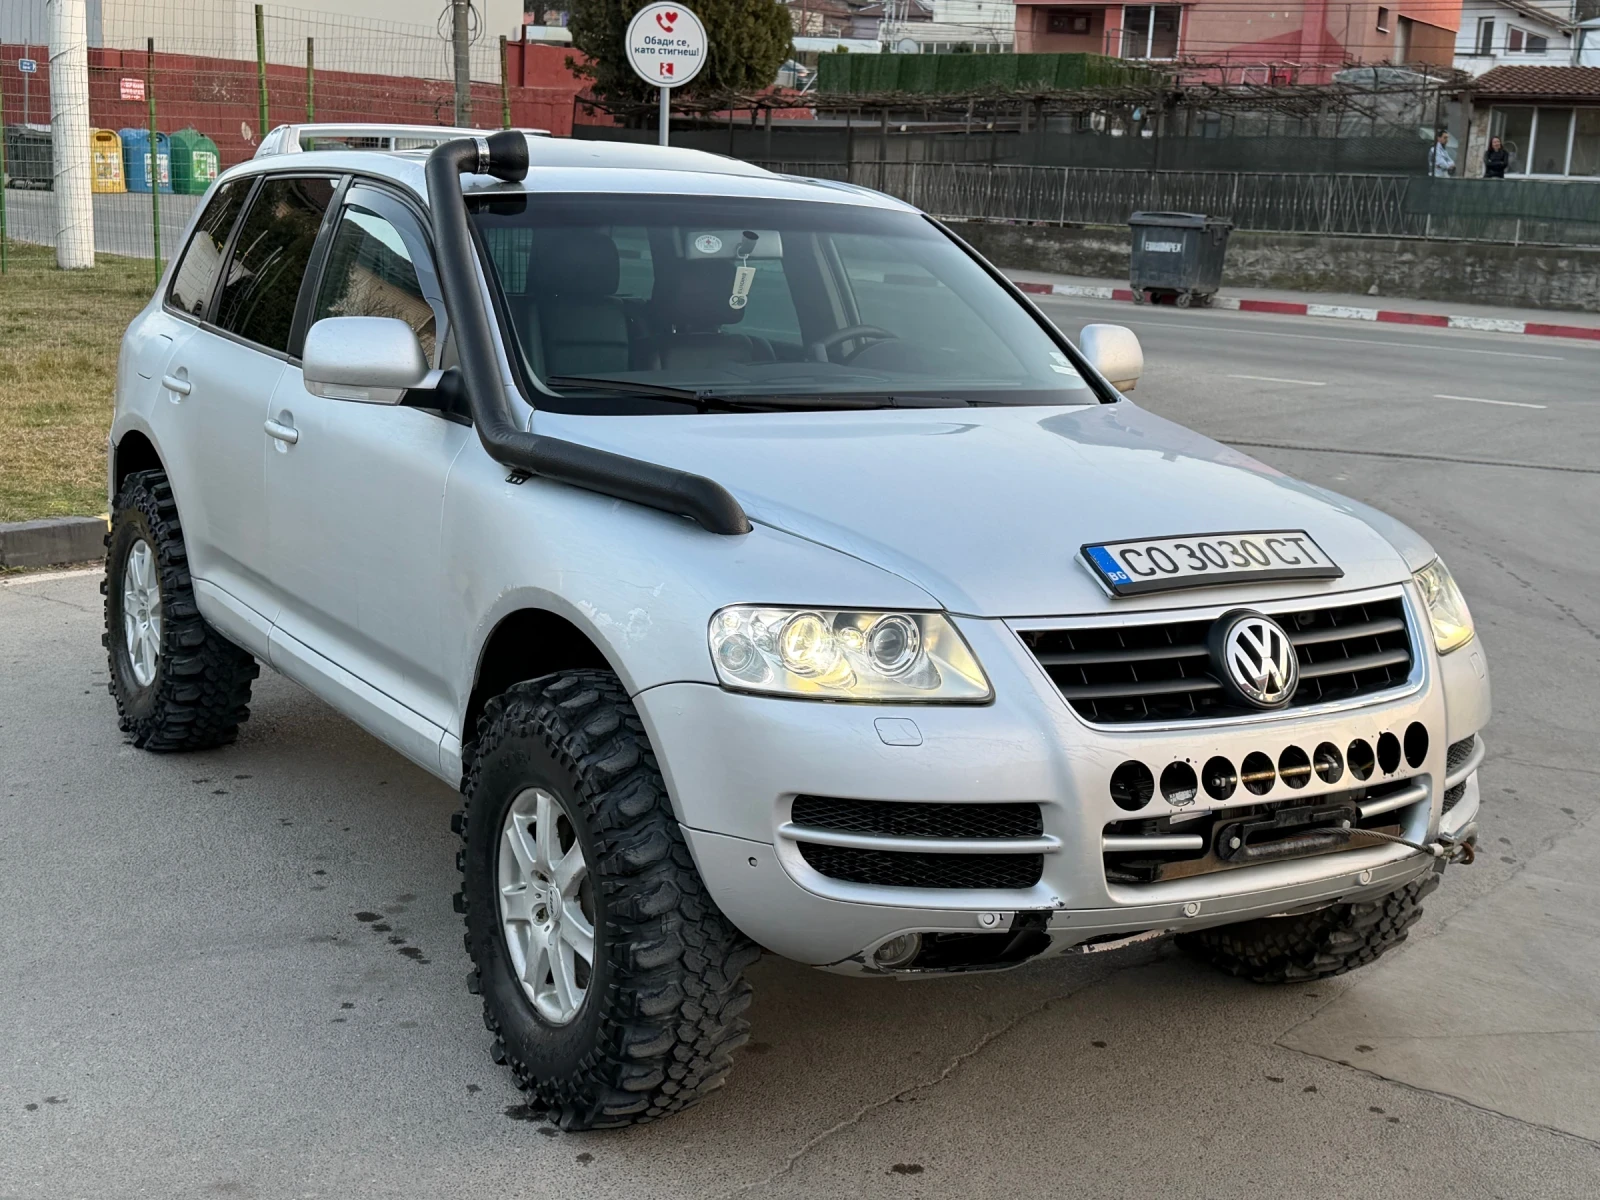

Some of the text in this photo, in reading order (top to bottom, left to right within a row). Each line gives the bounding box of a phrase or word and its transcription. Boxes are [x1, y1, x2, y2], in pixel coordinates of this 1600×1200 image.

[644, 36, 690, 48] Обади се,
[634, 47, 699, 57] като стигнеш!
[1108, 571, 1127, 581] BG
